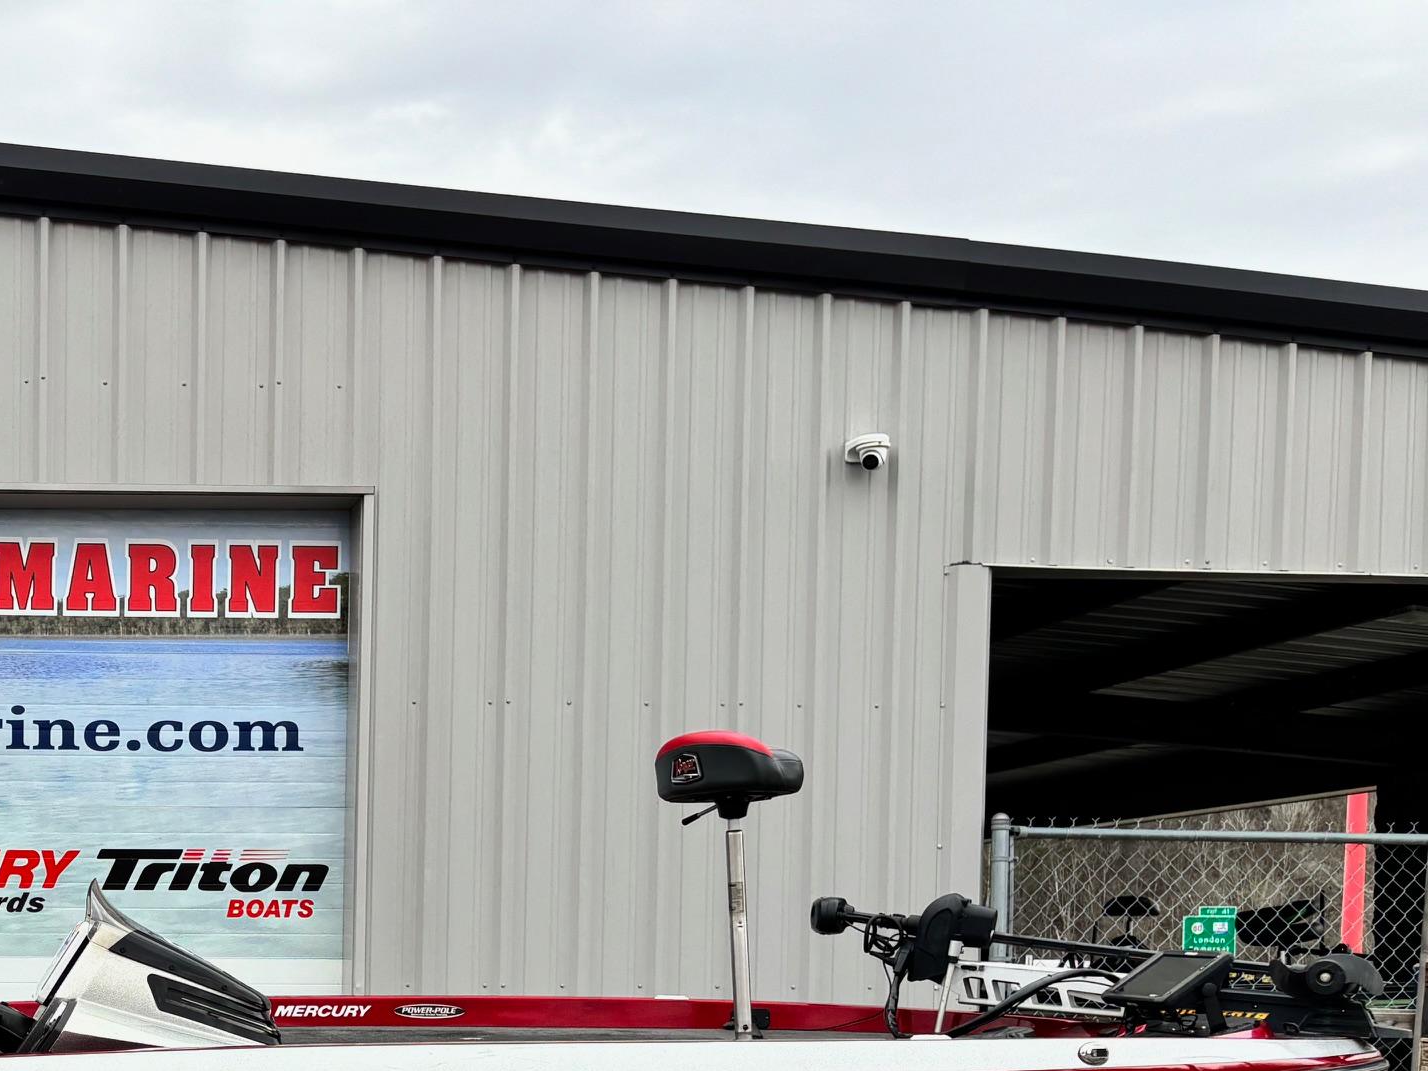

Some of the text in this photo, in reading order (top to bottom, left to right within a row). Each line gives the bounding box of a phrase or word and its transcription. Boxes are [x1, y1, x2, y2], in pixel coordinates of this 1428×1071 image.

[97, 848, 330, 893] Triton
[226, 899, 315, 918] BOATS
[1193, 936, 1226, 944] London
[274, 1004, 372, 1018] MERCURY
[401, 1006, 457, 1014] POWER-POLE
